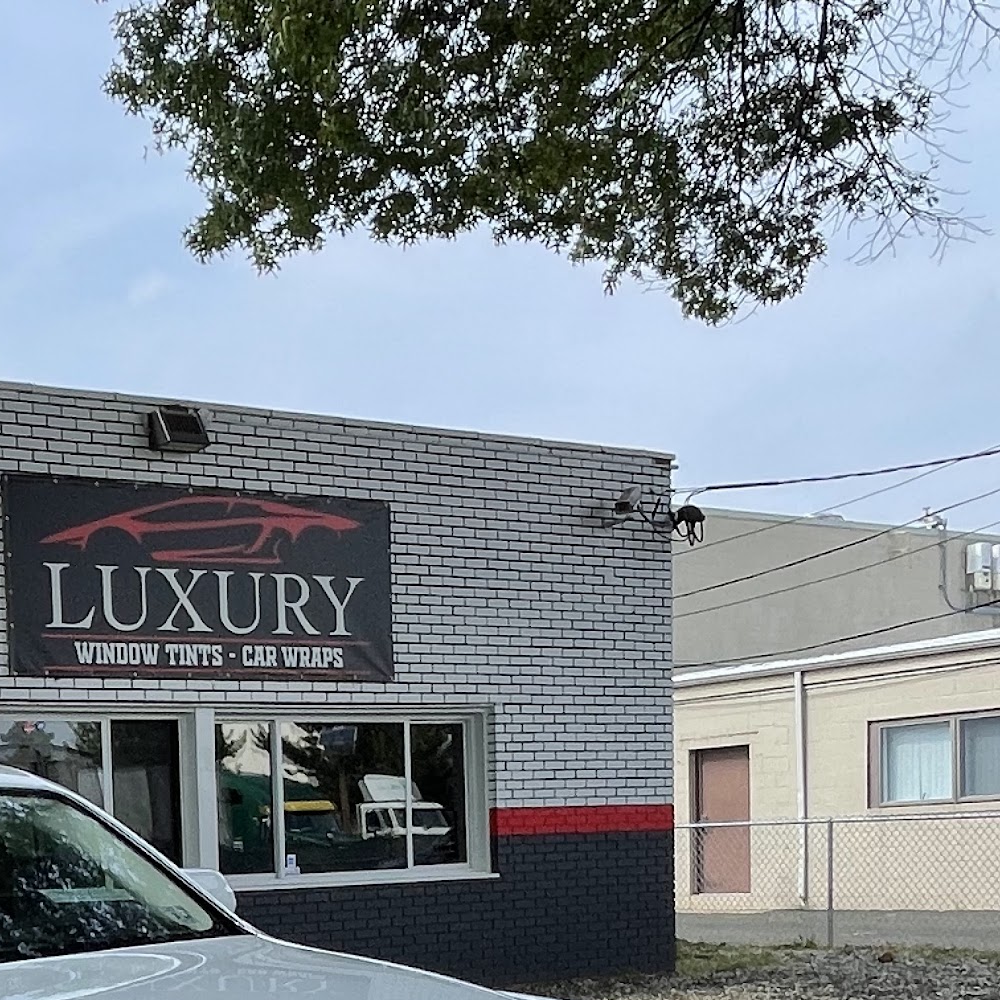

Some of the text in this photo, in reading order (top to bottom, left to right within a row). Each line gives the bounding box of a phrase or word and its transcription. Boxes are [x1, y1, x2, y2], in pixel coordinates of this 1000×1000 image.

[42, 561, 365, 636] LUXURY
[74, 641, 160, 665] WINDOW
[165, 643, 223, 667] TINTS
[242, 645, 277, 667] CAR
[281, 646, 343, 668] WRAPS
